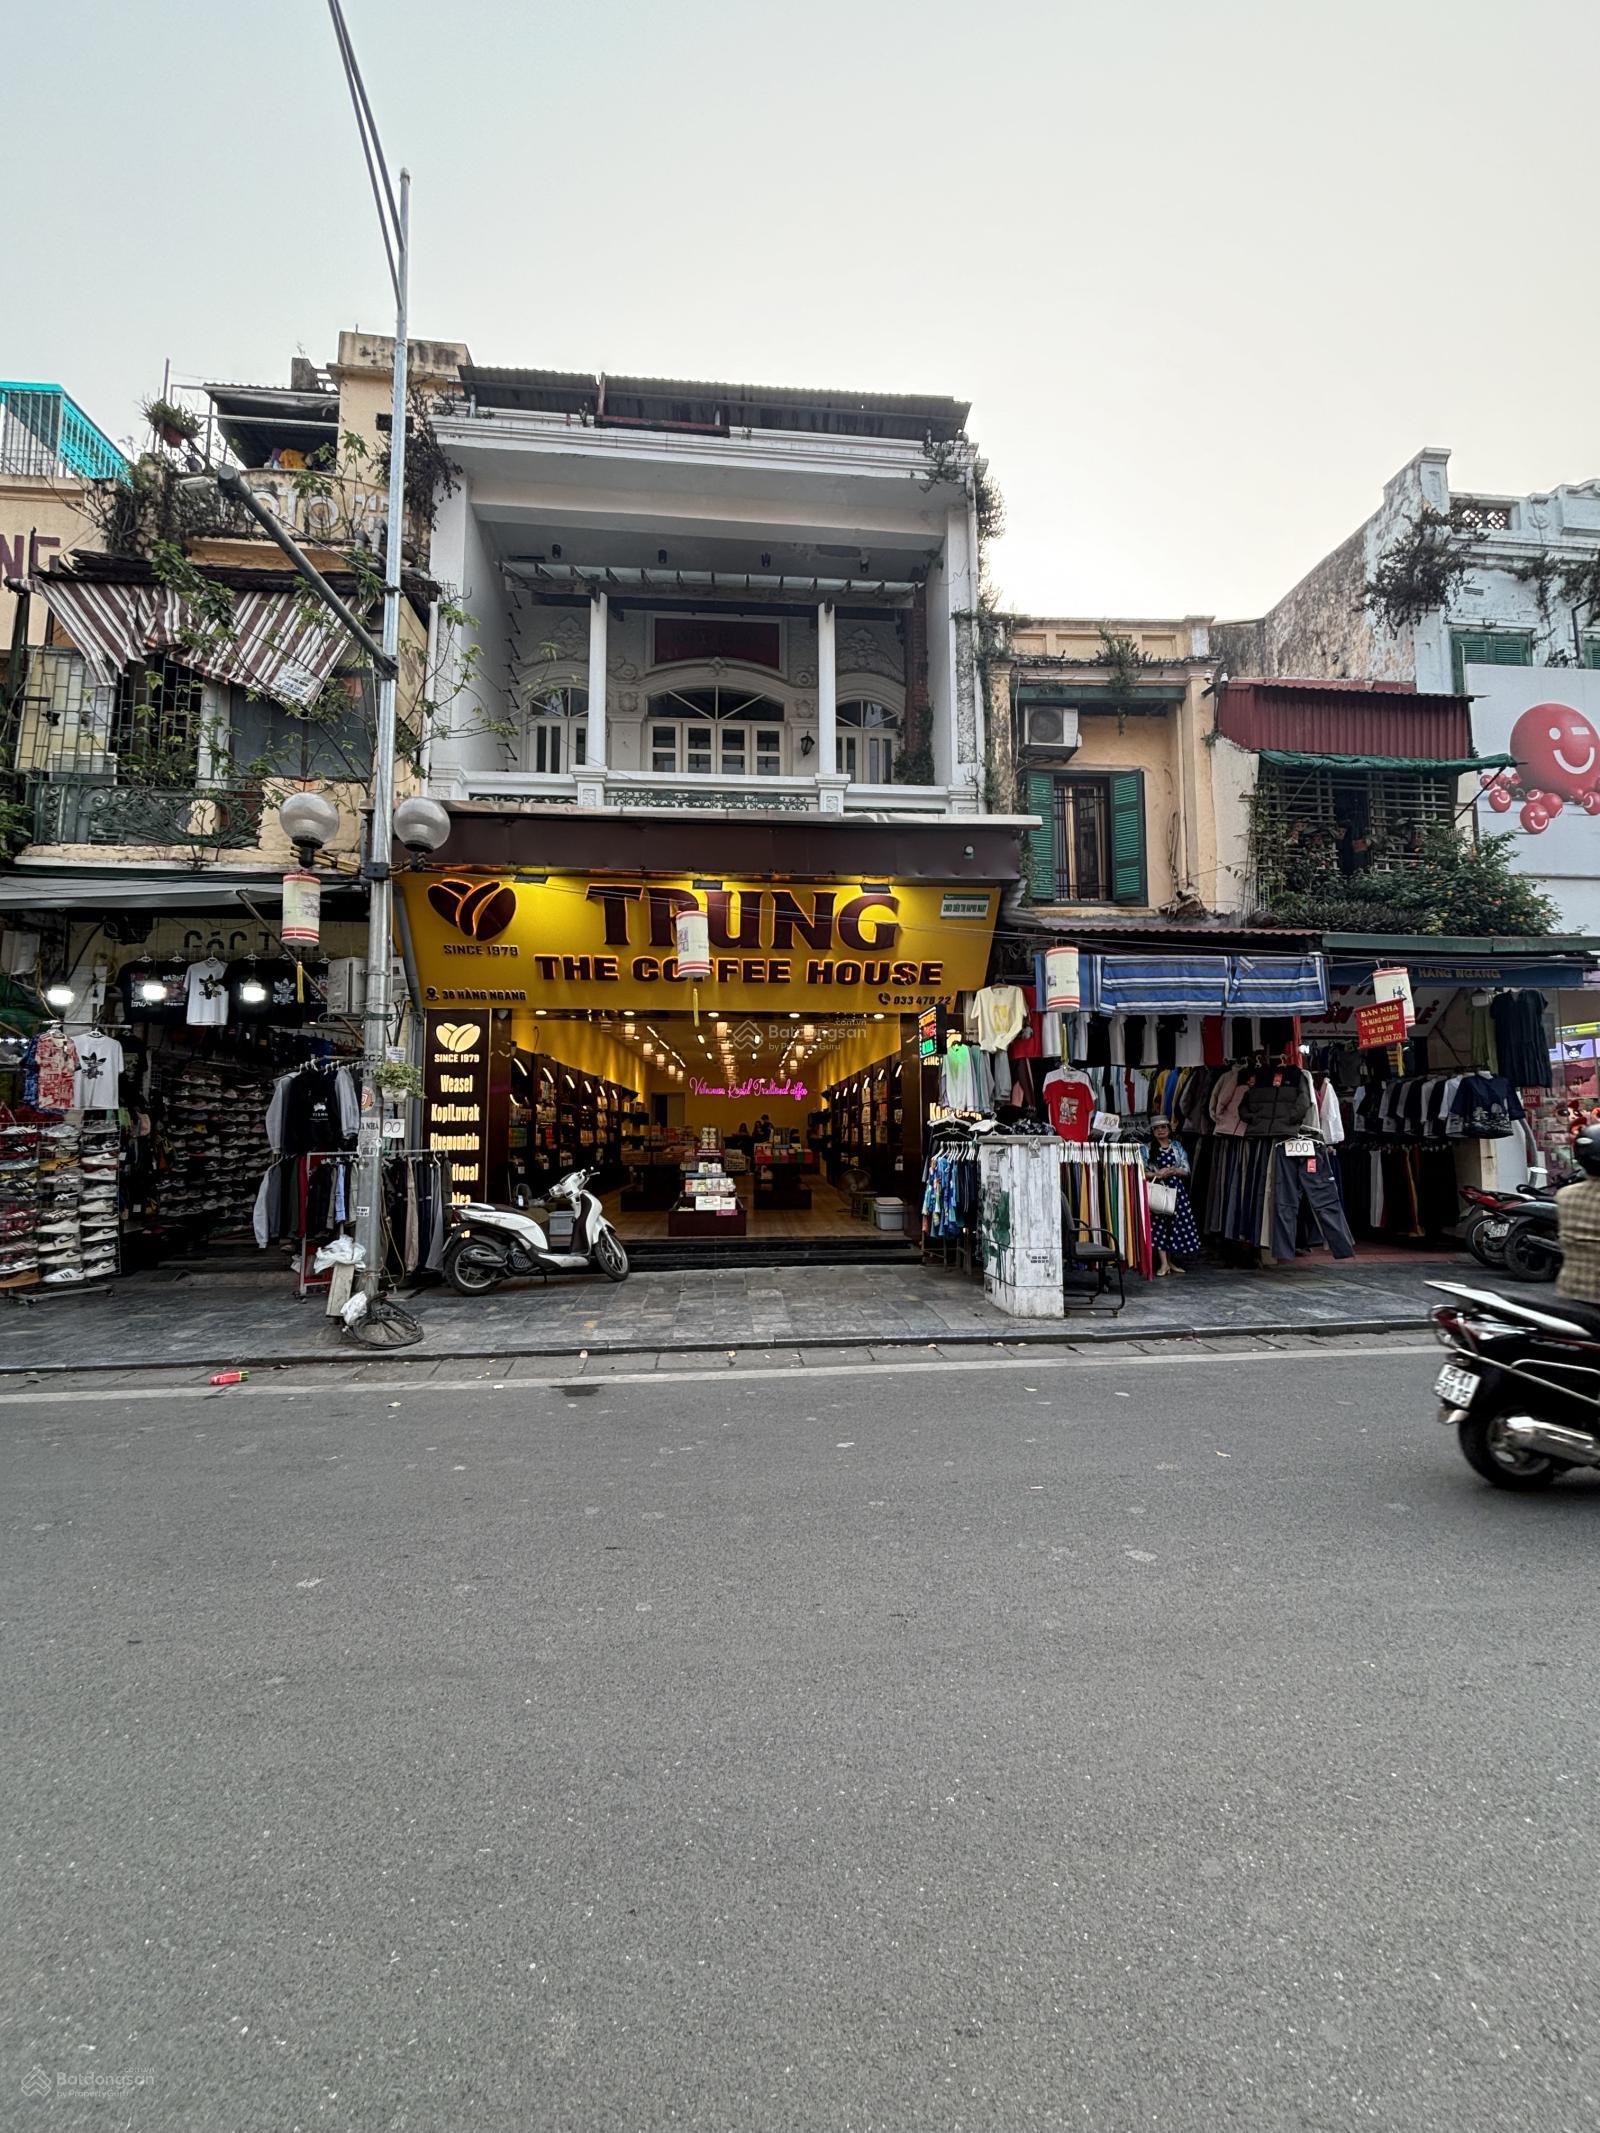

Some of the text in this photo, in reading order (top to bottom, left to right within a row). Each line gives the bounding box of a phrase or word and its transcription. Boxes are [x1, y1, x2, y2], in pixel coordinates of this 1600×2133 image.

[443, 944, 483, 955] SINCE
[535, 955, 943, 985] THE COFEE HOUSE
[490, 989, 526, 1001] NGANG
[434, 1054, 480, 1062] SINCE 1979
[440, 1075, 473, 1093] Weasel
[430, 1133, 480, 1150] Bluemountain
